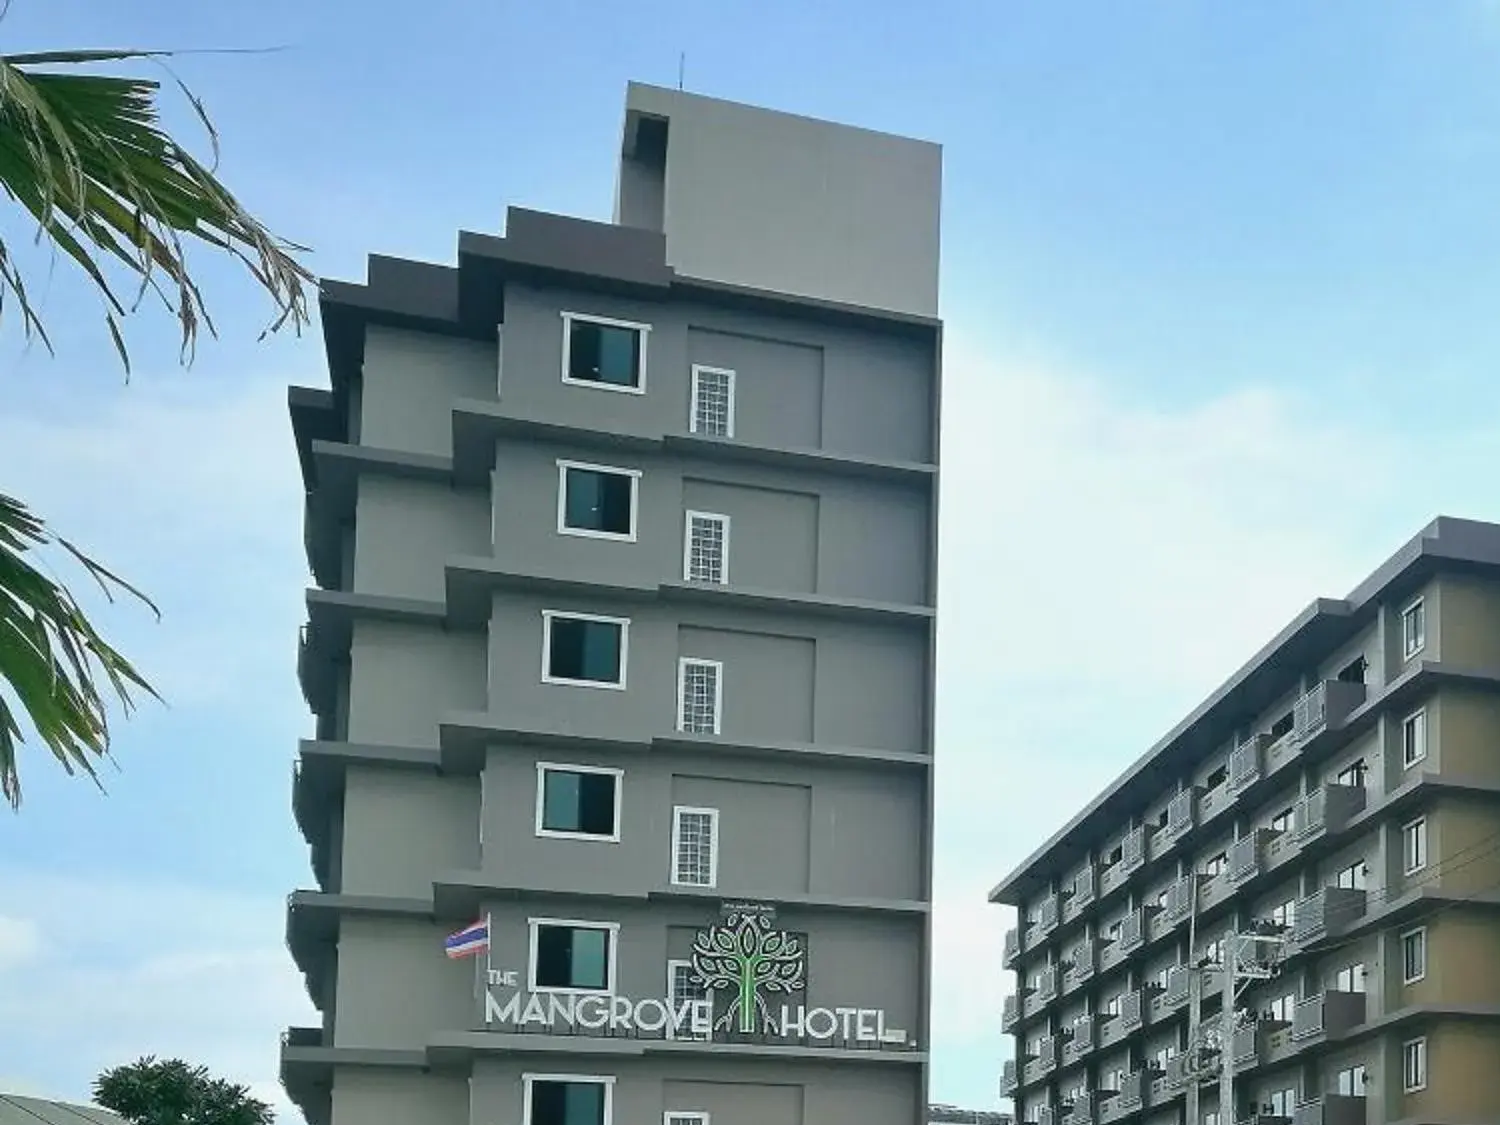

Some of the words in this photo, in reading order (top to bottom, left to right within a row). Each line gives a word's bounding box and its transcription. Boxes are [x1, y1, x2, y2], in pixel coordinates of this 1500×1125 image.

[487, 969, 519, 986] THE
[486, 988, 713, 1032] MANGROVE
[781, 1004, 897, 1041] HOTEL
